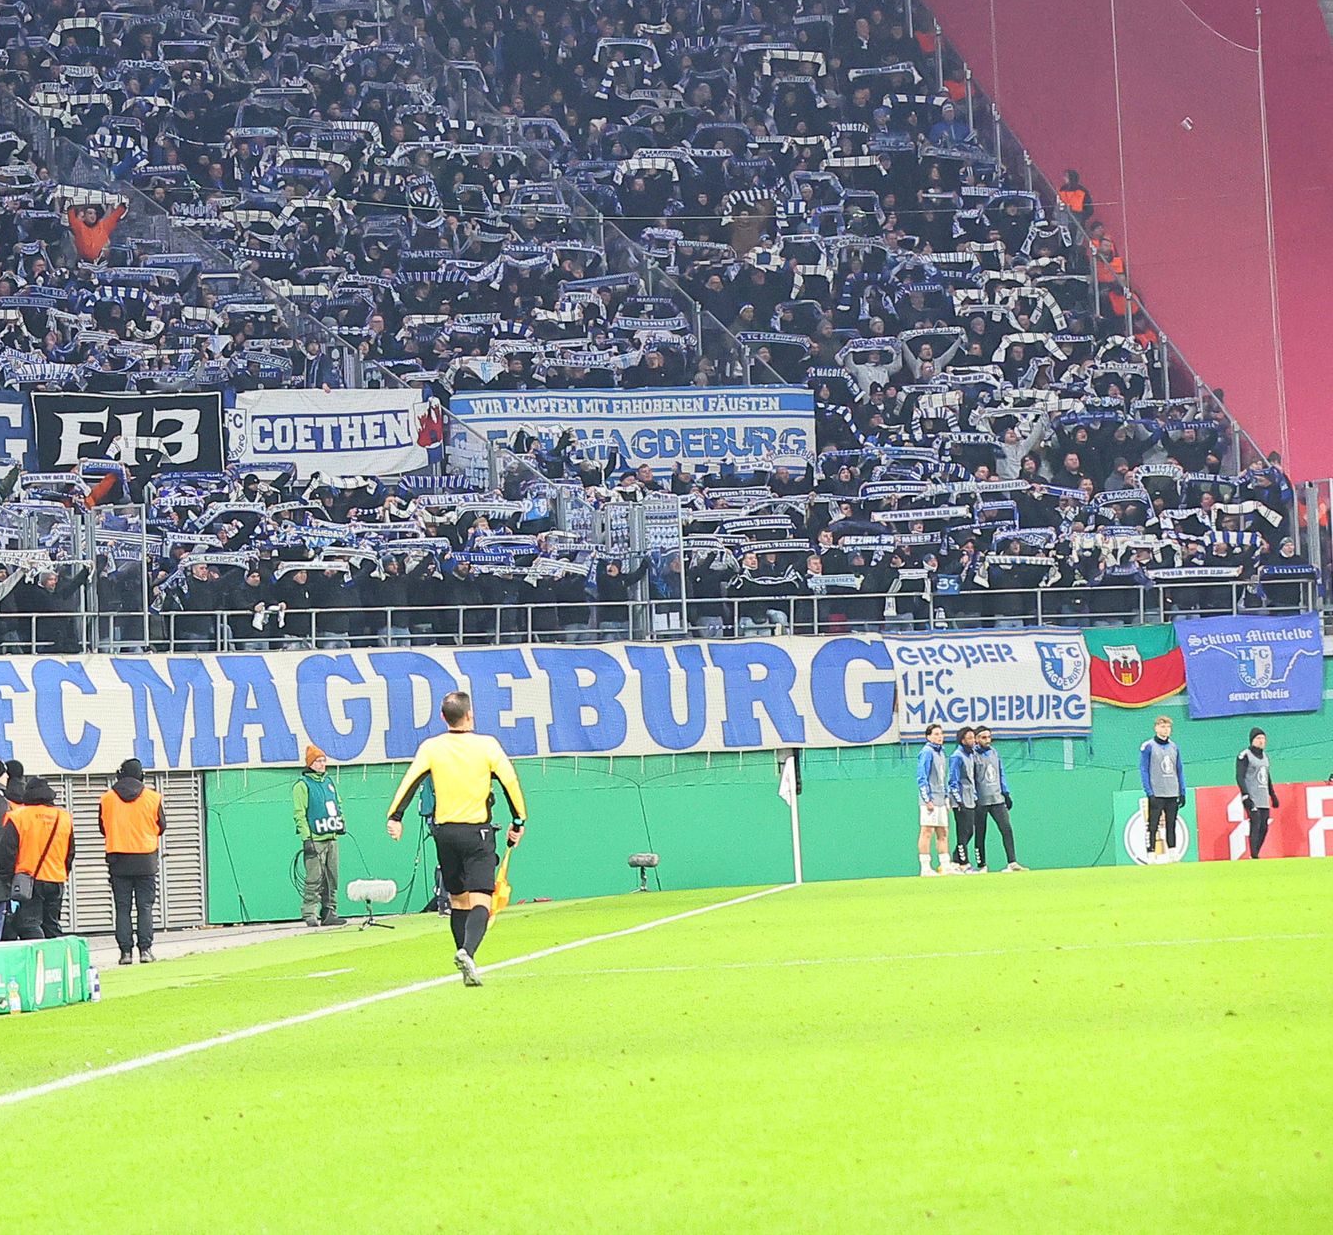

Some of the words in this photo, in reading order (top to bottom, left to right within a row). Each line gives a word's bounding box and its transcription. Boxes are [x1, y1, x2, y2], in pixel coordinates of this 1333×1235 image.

[470, 398, 502, 415] WIR
[505, 394, 579, 415] KÄMPFEN
[582, 397, 610, 414] MIT
[611, 396, 705, 414] ERHOBENEN
[707, 394, 781, 413] FÄUSTEN
[251, 412, 413, 452] COETHEN
[575, 426, 808, 461] MAGDEBURG
[844, 535, 879, 546] BEZIRK
[881, 535, 894, 545] 39
[470, 551, 507, 564] immer
[1187, 633, 1242, 647] Sektion
[1244, 628, 1314, 644] Mittelelbe
[896, 643, 1019, 669] GROßER
[902, 669, 955, 696] 1.FC
[1043, 659, 1083, 688] MAGDEBURG
[114, 639, 894, 770] MAGDEBURG
[906, 694, 1086, 725] MAGDEBURG
[315, 816, 345, 834] HOS
